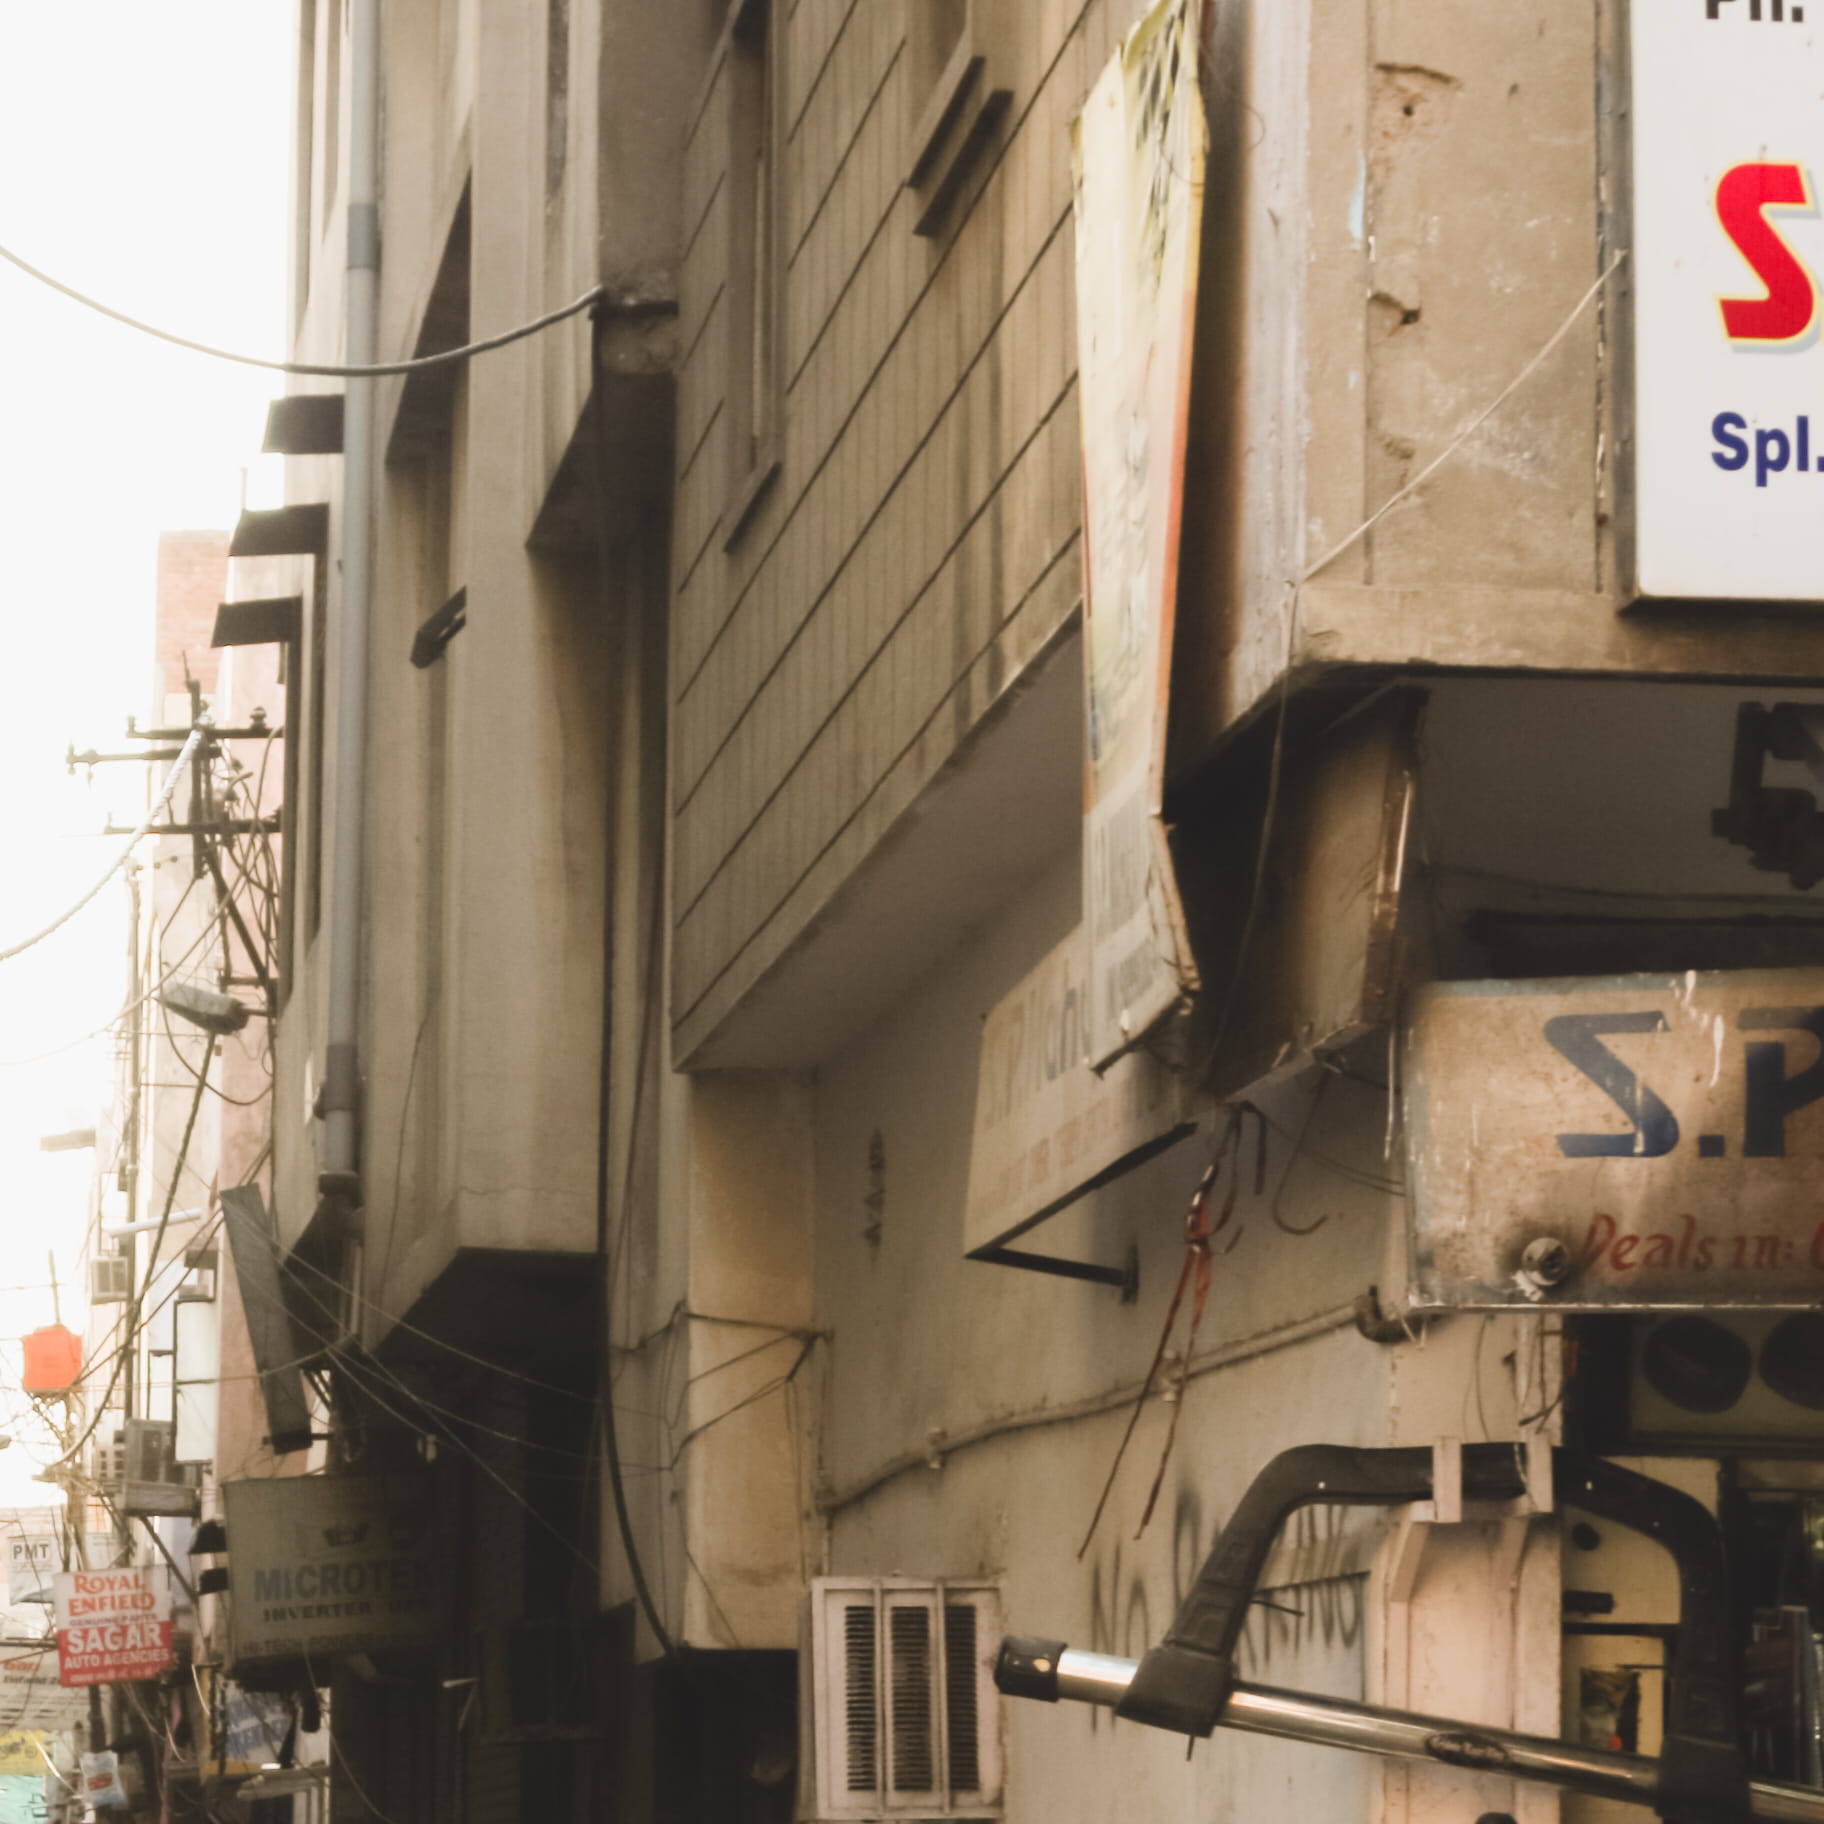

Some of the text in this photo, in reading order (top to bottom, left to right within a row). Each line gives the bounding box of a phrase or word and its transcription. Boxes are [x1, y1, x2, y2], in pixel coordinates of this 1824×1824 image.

[1715, 163, 1824, 342] S
[1582, 1212, 1713, 1272] Deals
[12, 1543, 49, 1560] PMT
[73, 1573, 146, 1594] ROYAL
[68, 1592, 156, 1617] ENFIELD
[66, 1622, 163, 1654] SAGAR
[64, 1648, 170, 1670] AUTO AGENCIES
